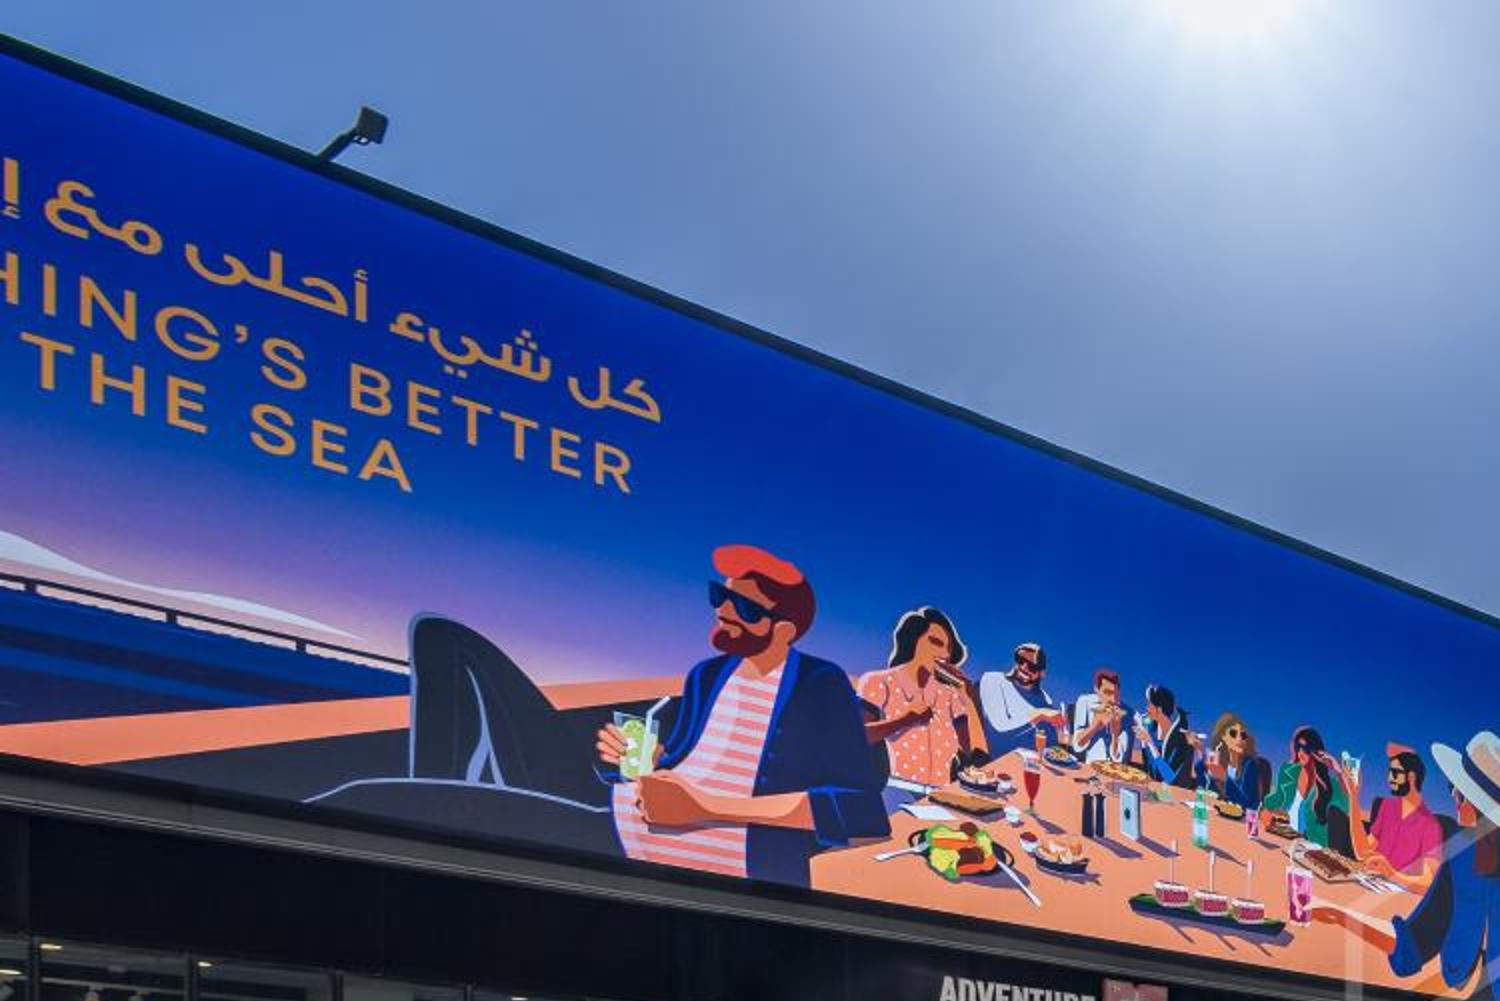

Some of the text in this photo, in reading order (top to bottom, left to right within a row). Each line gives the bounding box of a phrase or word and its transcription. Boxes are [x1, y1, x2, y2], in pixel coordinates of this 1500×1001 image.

[43, 179, 164, 256] مع
[184, 249, 368, 323] أحلى
[389, 311, 551, 384] شيء
[20, 331, 413, 493] THE SEA
[350, 362, 631, 494] BETTER
[567, 366, 661, 424] كل
